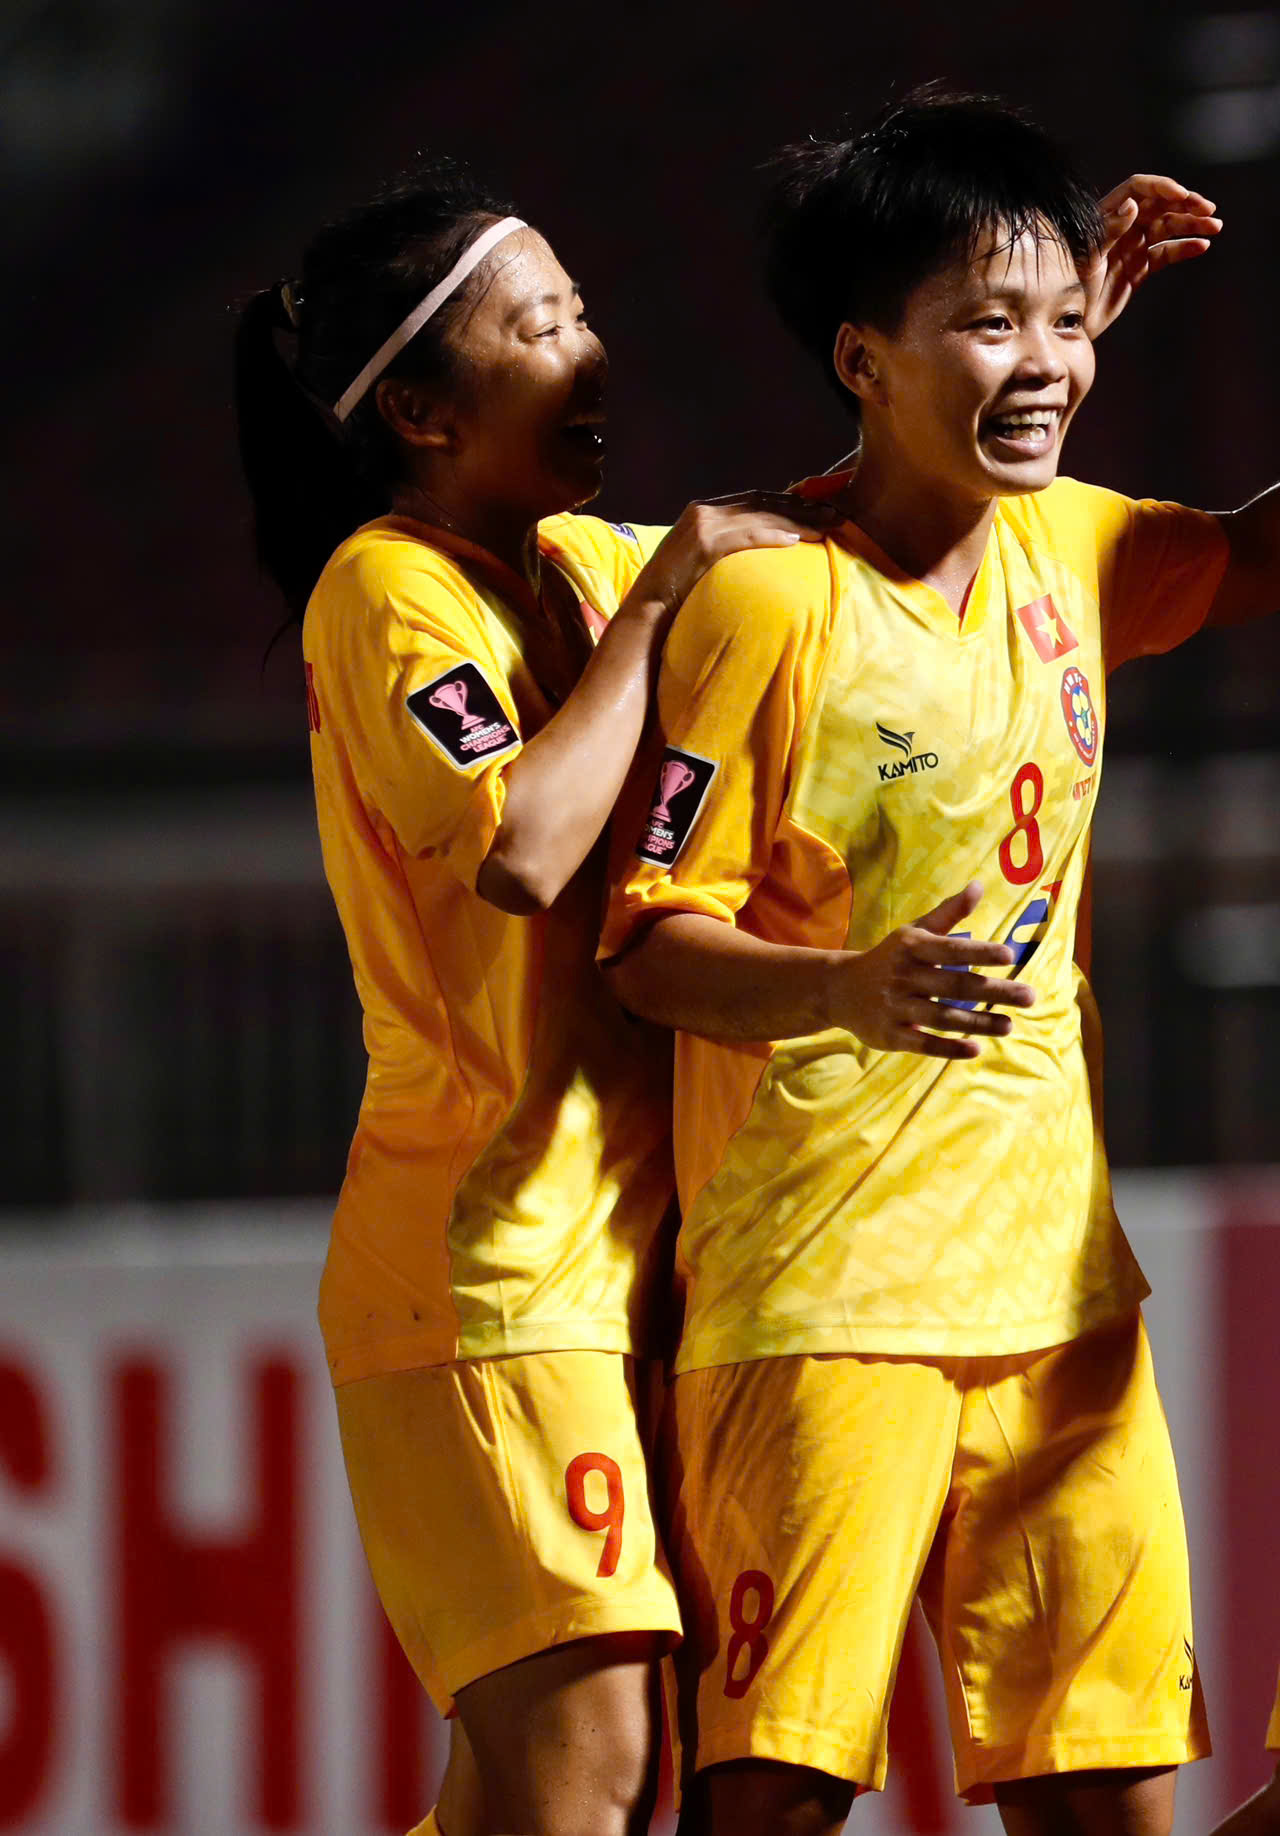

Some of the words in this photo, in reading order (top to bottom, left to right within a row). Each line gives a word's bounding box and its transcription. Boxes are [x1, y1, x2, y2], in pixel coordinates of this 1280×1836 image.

[459, 722, 501, 744] WOMEN'S
[460, 725, 511, 751] CHAMPIONS
[877, 752, 939, 782] KAMITO
[998, 762, 1044, 885] 8
[565, 1452, 625, 1577] 9
[723, 1569, 775, 1699] 8
